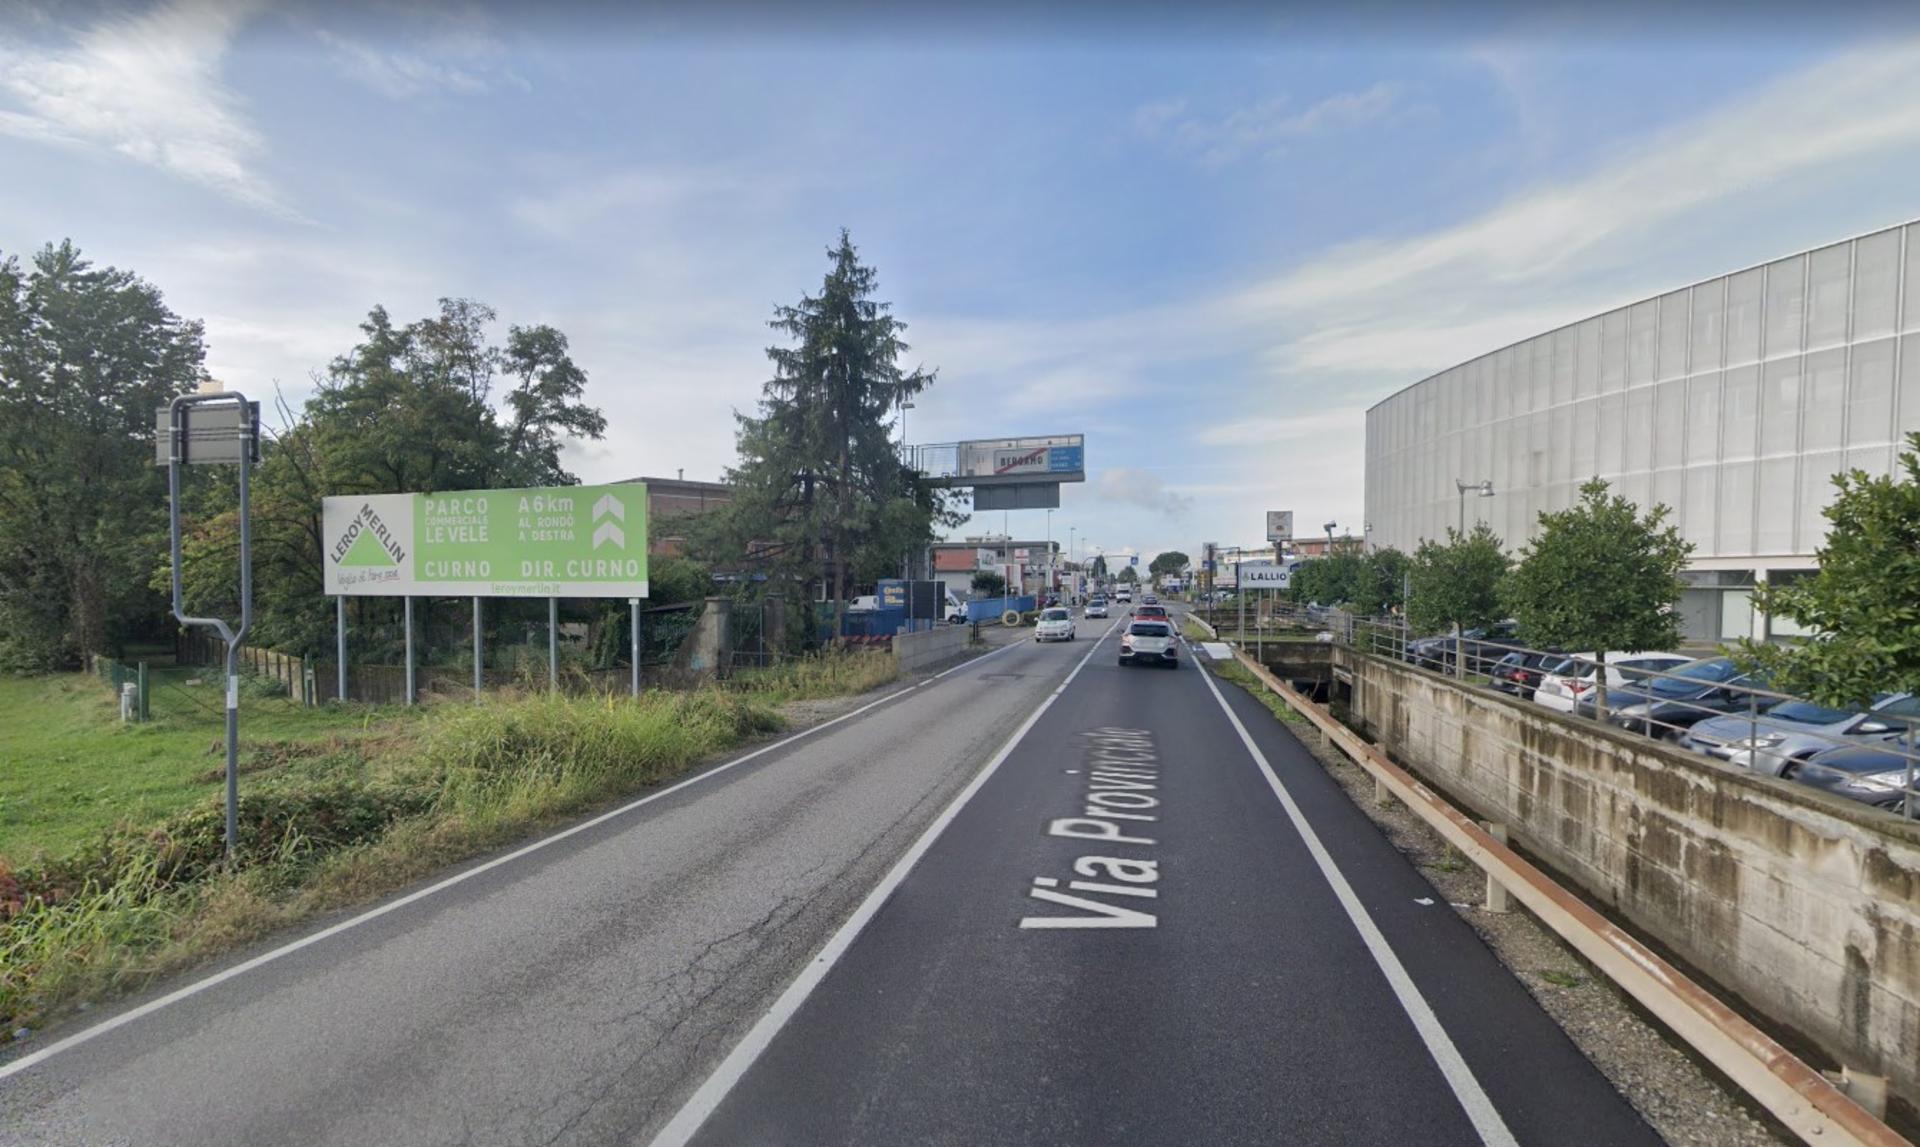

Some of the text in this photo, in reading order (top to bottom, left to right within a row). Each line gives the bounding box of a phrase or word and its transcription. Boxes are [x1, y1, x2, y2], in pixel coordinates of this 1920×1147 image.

[425, 498, 488, 515] PARCO
[518, 494, 574, 513] A 6 km
[518, 517, 531, 529] AL
[330, 503, 405, 564] LEROY MERLIN
[425, 526, 489, 543] LE VELE
[518, 529, 575, 541] A DESTRA
[425, 560, 490, 578] CURNO
[521, 559, 639, 578] DIR. CURNO
[1250, 571, 1287, 581] LALLIO
